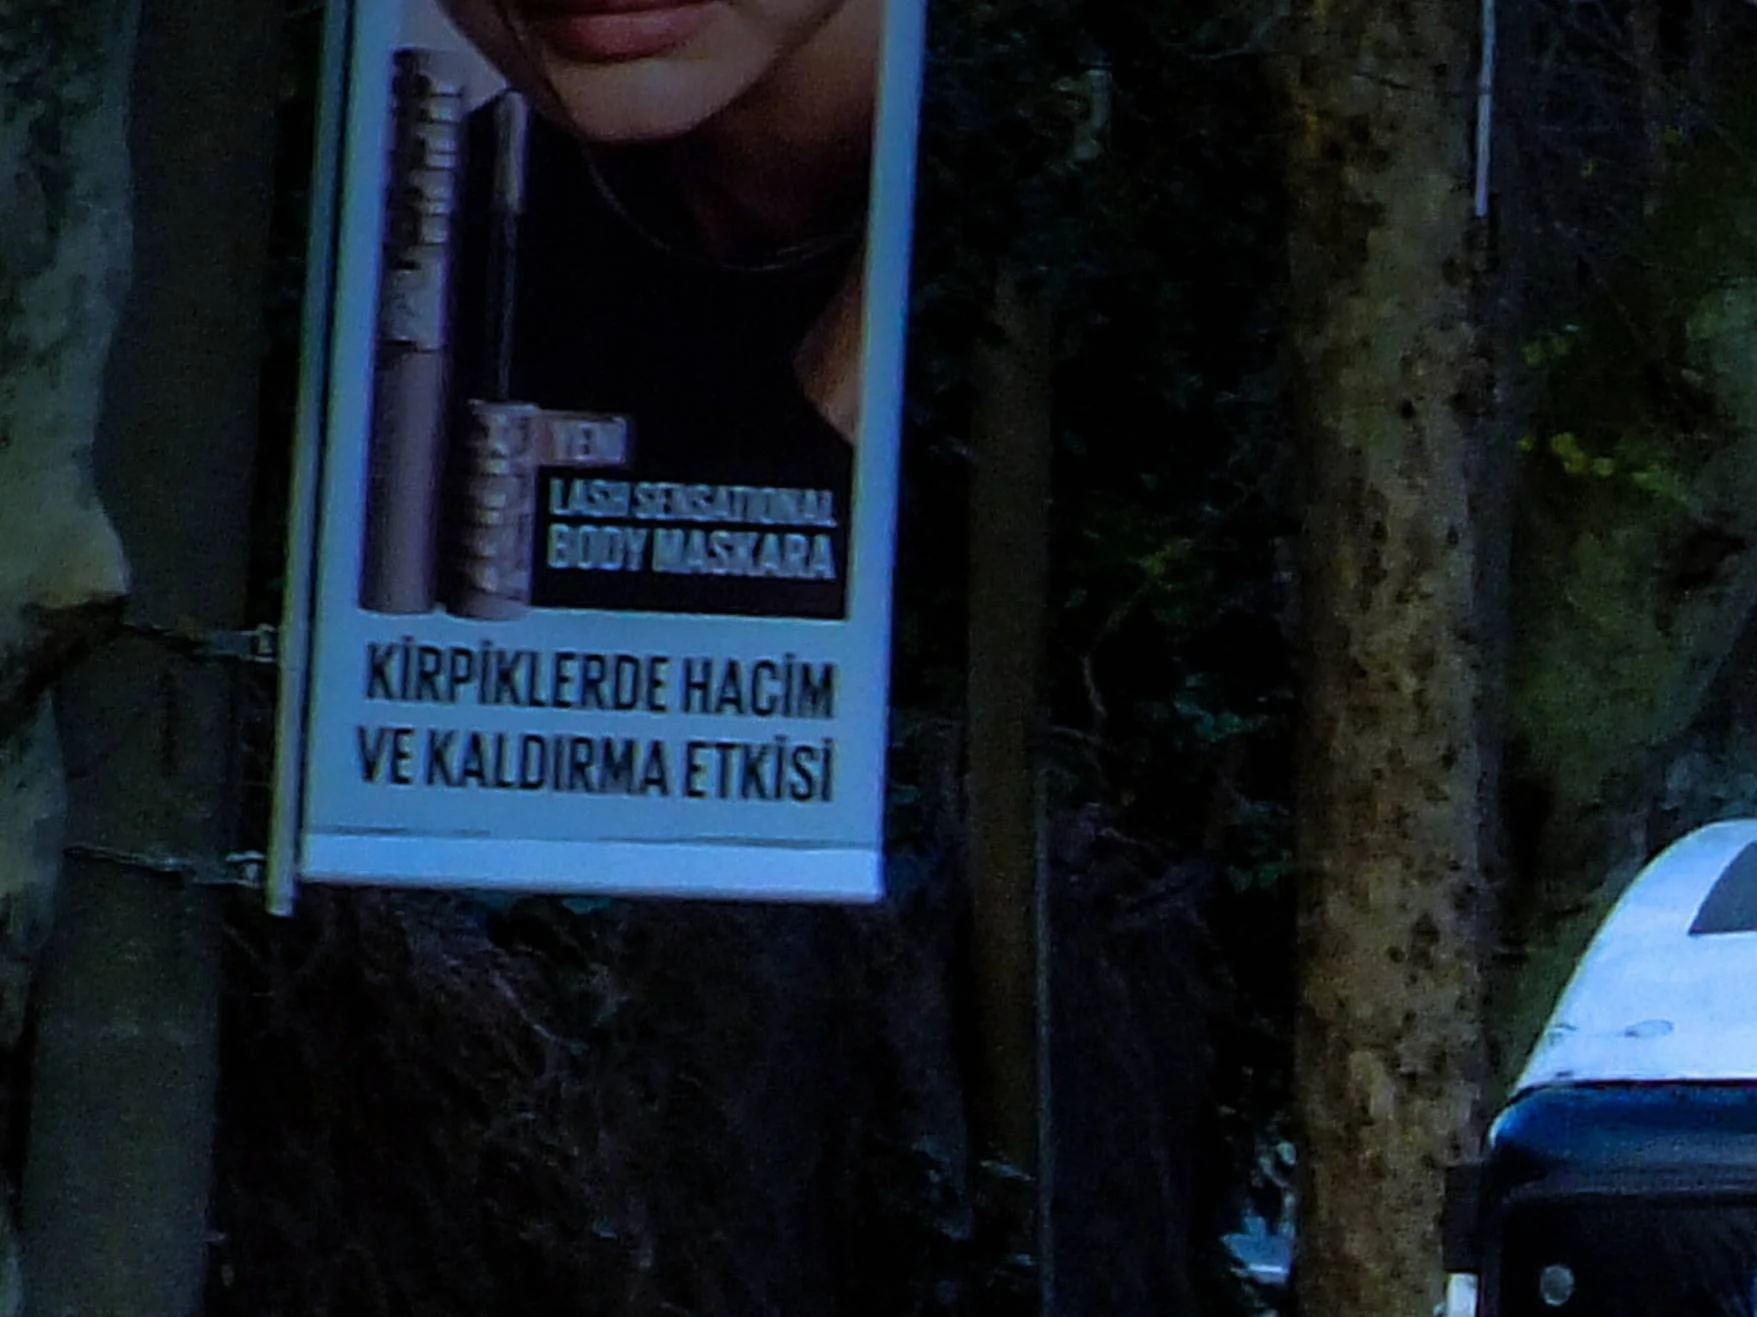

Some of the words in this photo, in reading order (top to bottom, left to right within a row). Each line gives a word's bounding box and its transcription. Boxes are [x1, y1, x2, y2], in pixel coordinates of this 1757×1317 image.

[549, 523, 648, 572] BODY
[652, 528, 837, 579] MASKARA
[366, 635, 670, 712] KİRPİKLERDE
[682, 653, 837, 719] HACİM
[357, 725, 416, 784] VE
[426, 729, 669, 795] KALDIRMA
[684, 735, 835, 800] ETKİSİ
